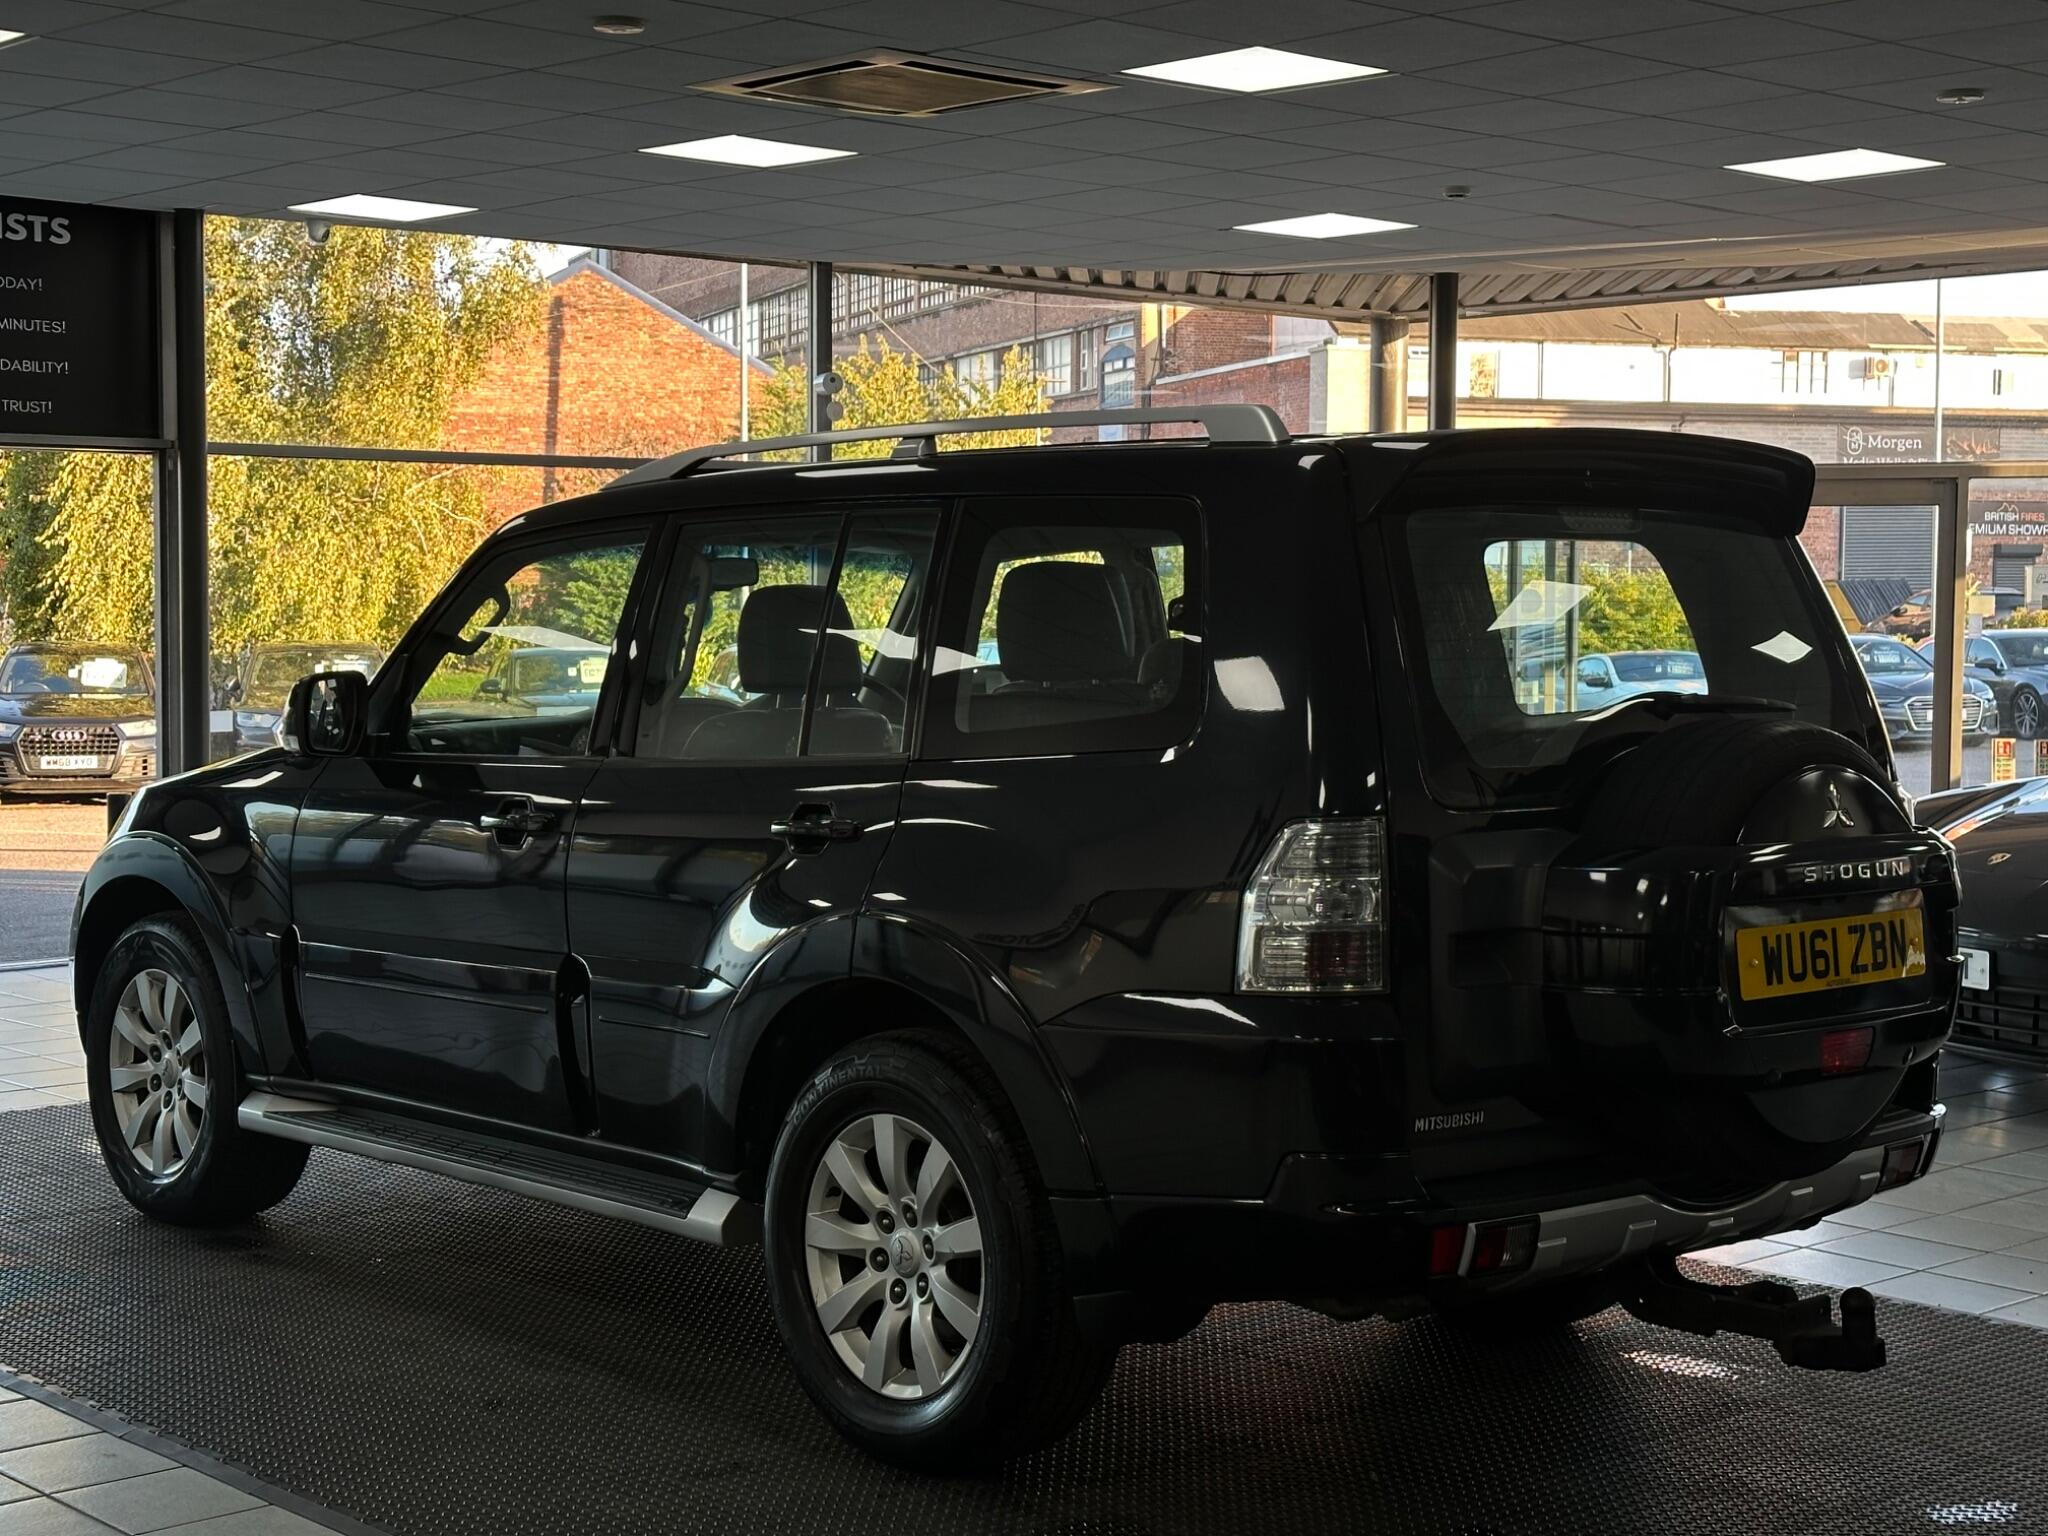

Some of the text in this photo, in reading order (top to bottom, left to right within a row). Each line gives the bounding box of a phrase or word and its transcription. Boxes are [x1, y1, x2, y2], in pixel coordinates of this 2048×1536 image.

[0, 212, 71, 245] STS
[0, 358, 69, 375] DABILITY!
[1, 399, 52, 414] TRUST!
[1867, 434, 1922, 452] Morgen
[1984, 511, 2019, 522] BRITISH
[1804, 861, 1904, 883] SHOGUN
[1761, 918, 1907, 987] WU61 ZBN
[1414, 1110, 1485, 1133] MITSUBISHI
